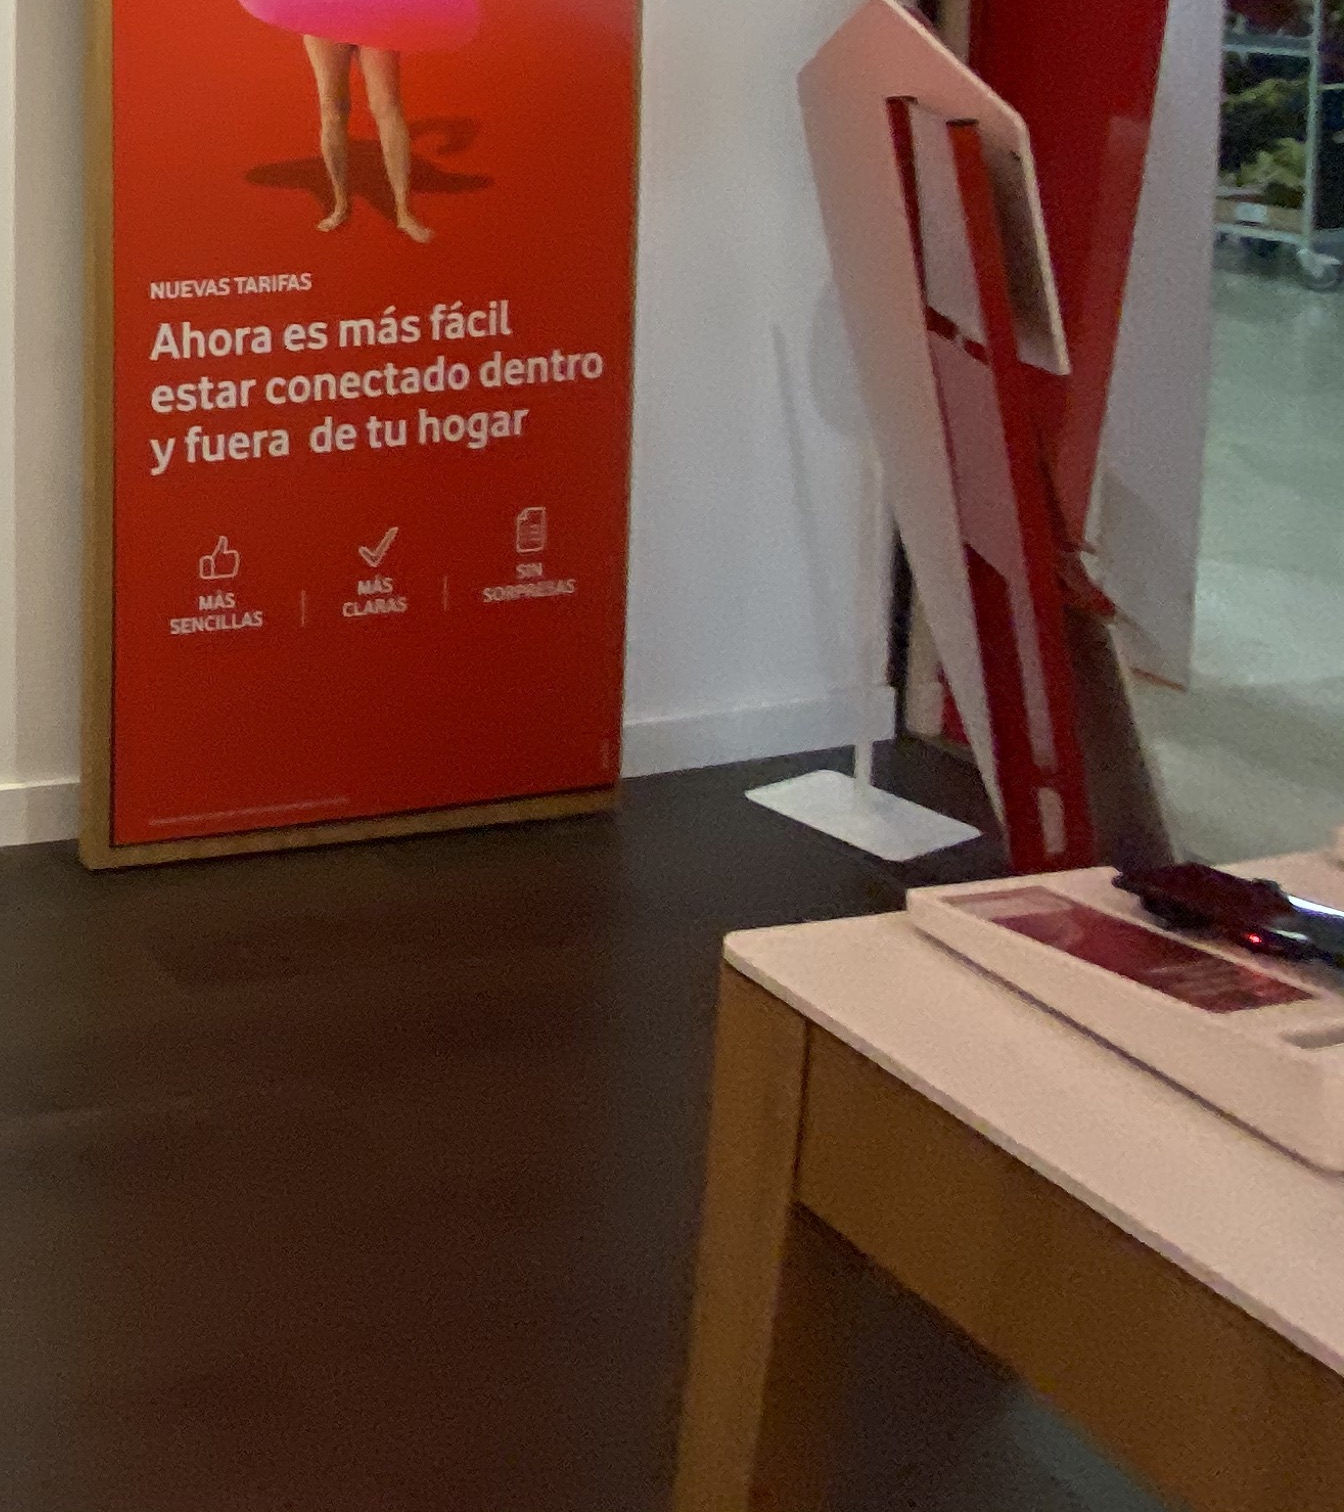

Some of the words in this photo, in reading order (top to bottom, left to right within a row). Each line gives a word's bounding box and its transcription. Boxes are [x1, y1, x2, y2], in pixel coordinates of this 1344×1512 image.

[150, 278, 231, 300] NUEVAS
[234, 272, 313, 296] TARIFAS
[149, 322, 272, 361] Ahora
[283, 321, 328, 352] es
[339, 305, 421, 348] más
[430, 299, 512, 341] fácil
[150, 376, 257, 414] estar
[265, 355, 470, 406] conectado
[479, 350, 604, 388] dentro
[149, 438, 175, 476] y
[184, 426, 290, 463] fuera
[310, 416, 356, 454] de
[366, 416, 408, 449] tu
[419, 408, 530, 450] hogar
[357, 574, 393, 597] MÁS
[198, 589, 235, 611] MÁS
[342, 597, 408, 618] CLARAS
[170, 612, 264, 636] SENCILLAS
